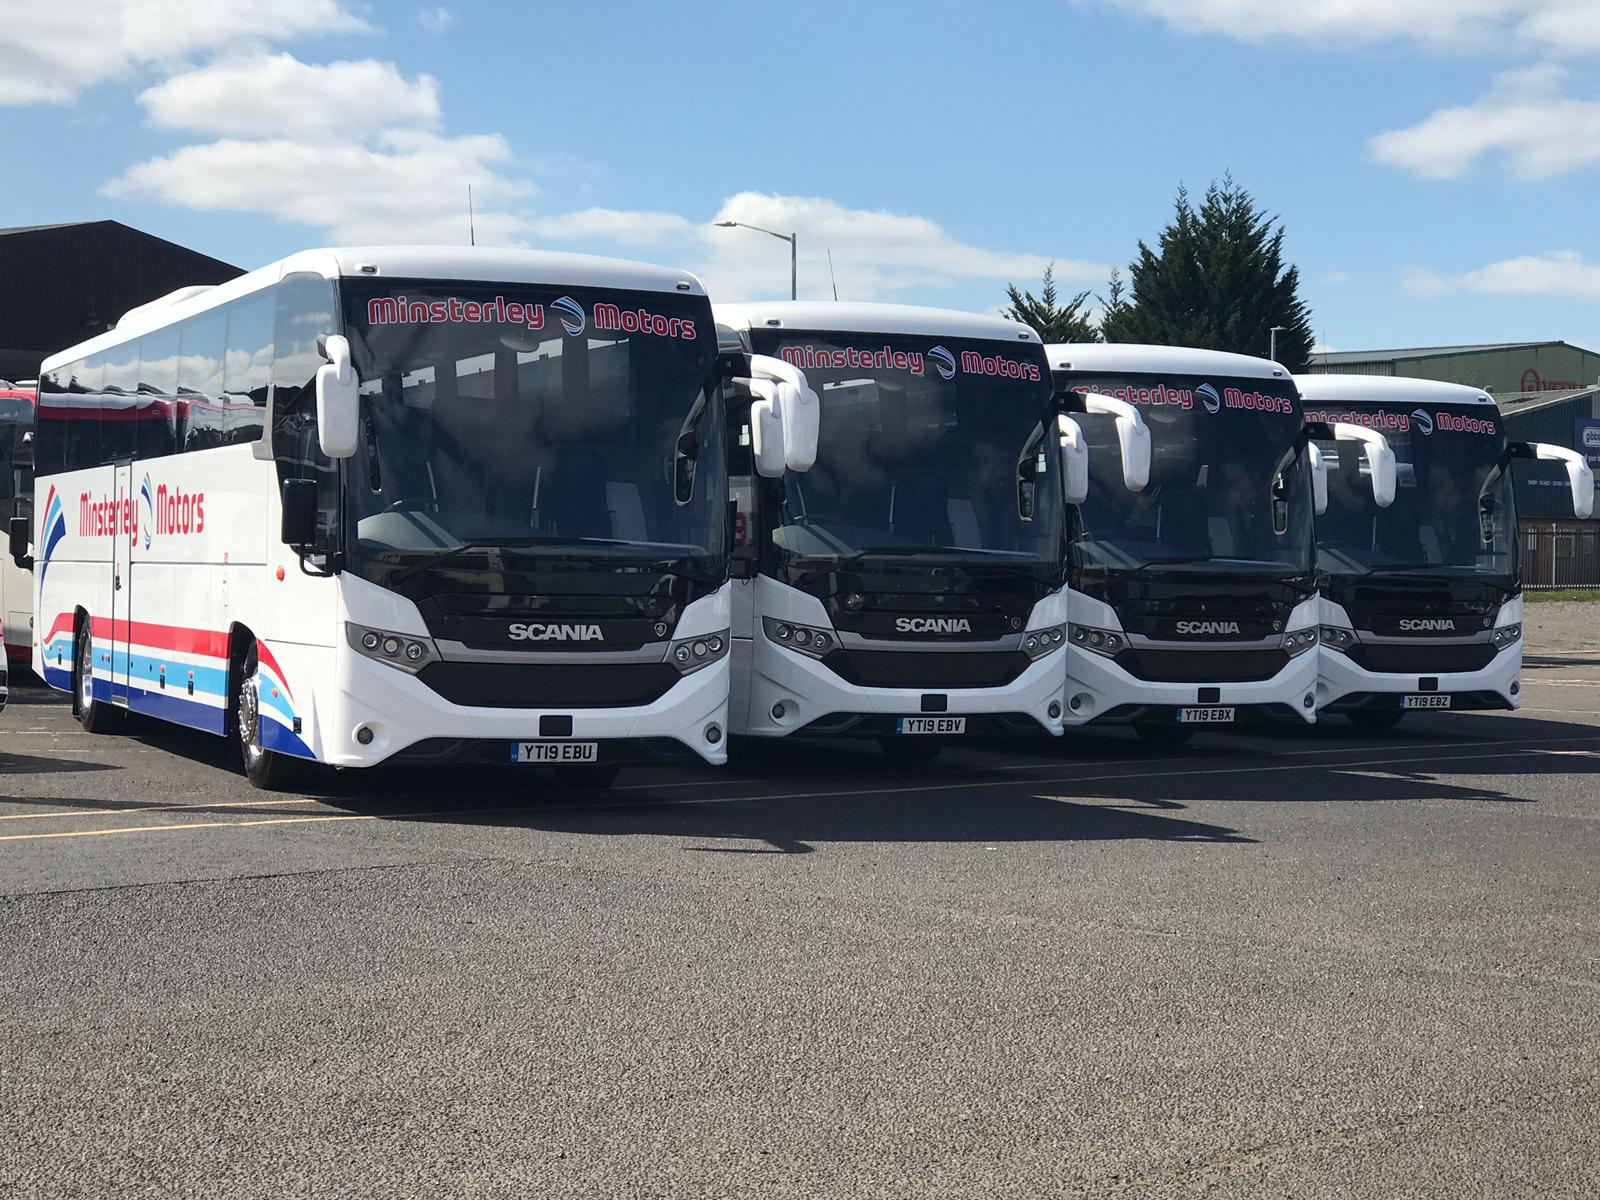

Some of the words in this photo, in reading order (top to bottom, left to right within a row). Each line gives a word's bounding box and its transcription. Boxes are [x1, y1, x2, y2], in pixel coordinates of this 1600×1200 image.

[367, 296, 546, 330] Minsterley
[594, 303, 697, 340] Motors
[781, 345, 924, 375] Minsterley
[961, 351, 1041, 381] Motors
[1224, 387, 1293, 413] Motors
[1435, 412, 1496, 435] Motors
[79, 485, 139, 547] Minsterley
[156, 483, 204, 536] Motors
[508, 623, 605, 641] SCANIA
[895, 617, 971, 633] SCANIA
[1176, 621, 1240, 634] SCANIA
[1399, 619, 1455, 631] SCANIA
[1407, 696, 1428, 707] YT19
[1429, 696, 1448, 707] EBZ
[1185, 709, 1209, 721] YT19
[1210, 709, 1232, 721] EBX
[907, 719, 935, 732] YT19
[937, 719, 962, 732] EBV
[524, 744, 559, 760] YT19
[562, 744, 593, 760] EBU
